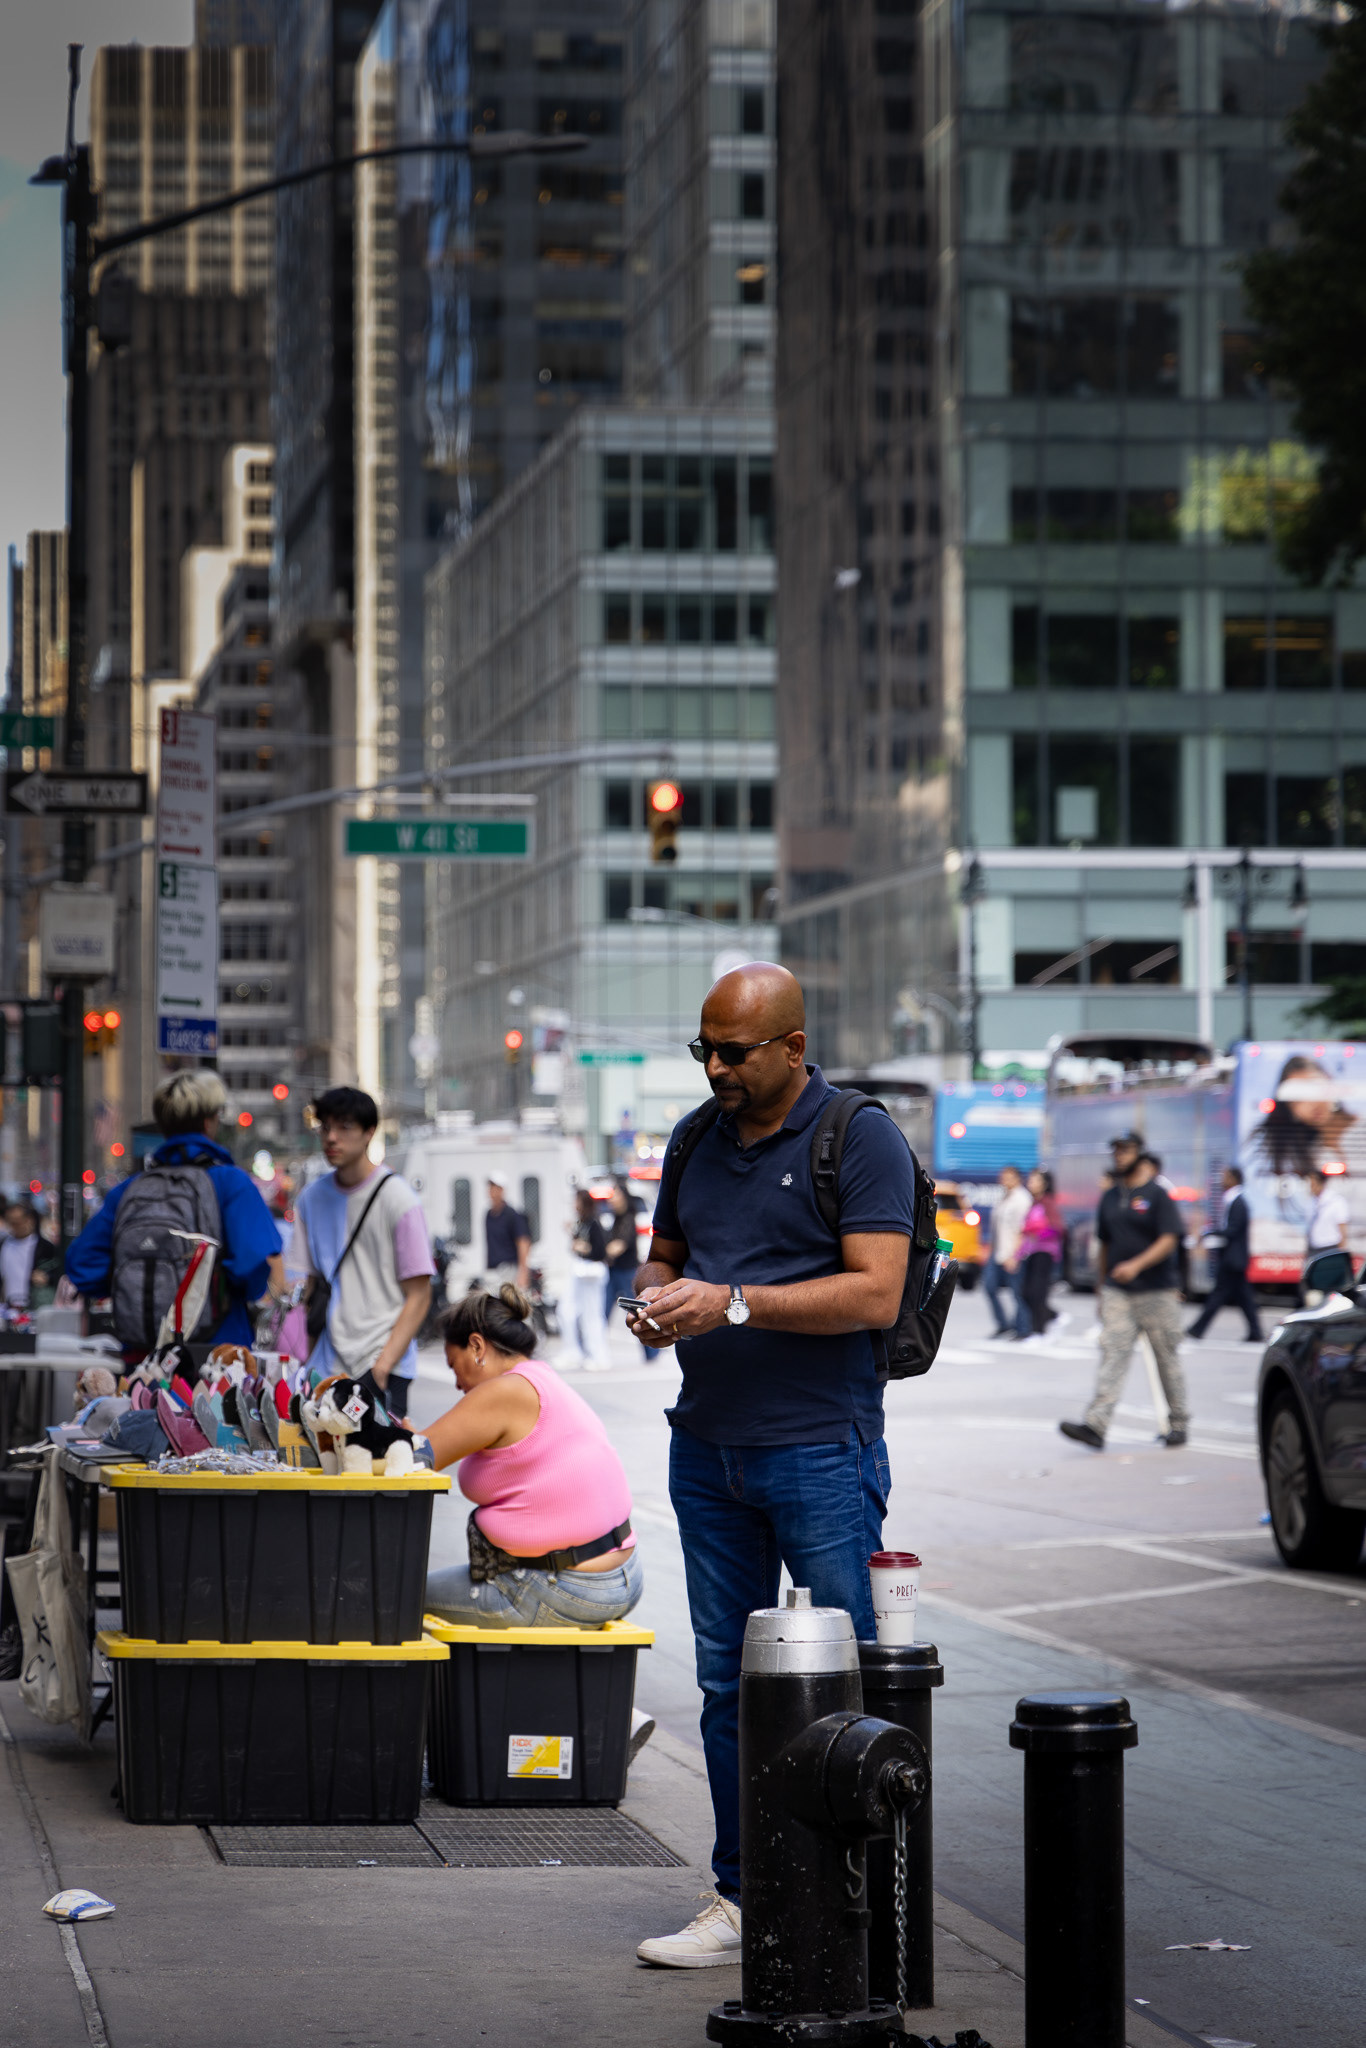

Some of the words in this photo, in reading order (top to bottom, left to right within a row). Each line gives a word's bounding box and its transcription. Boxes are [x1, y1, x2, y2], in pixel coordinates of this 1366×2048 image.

[164, 710, 174, 743] 3
[24, 782, 66, 801] ONE
[85, 782, 128, 801] WAY
[396, 824, 417, 850] W
[163, 864, 175, 897] 5
[897, 1585, 913, 1596] PRET
[511, 1738, 533, 1748] HDX
